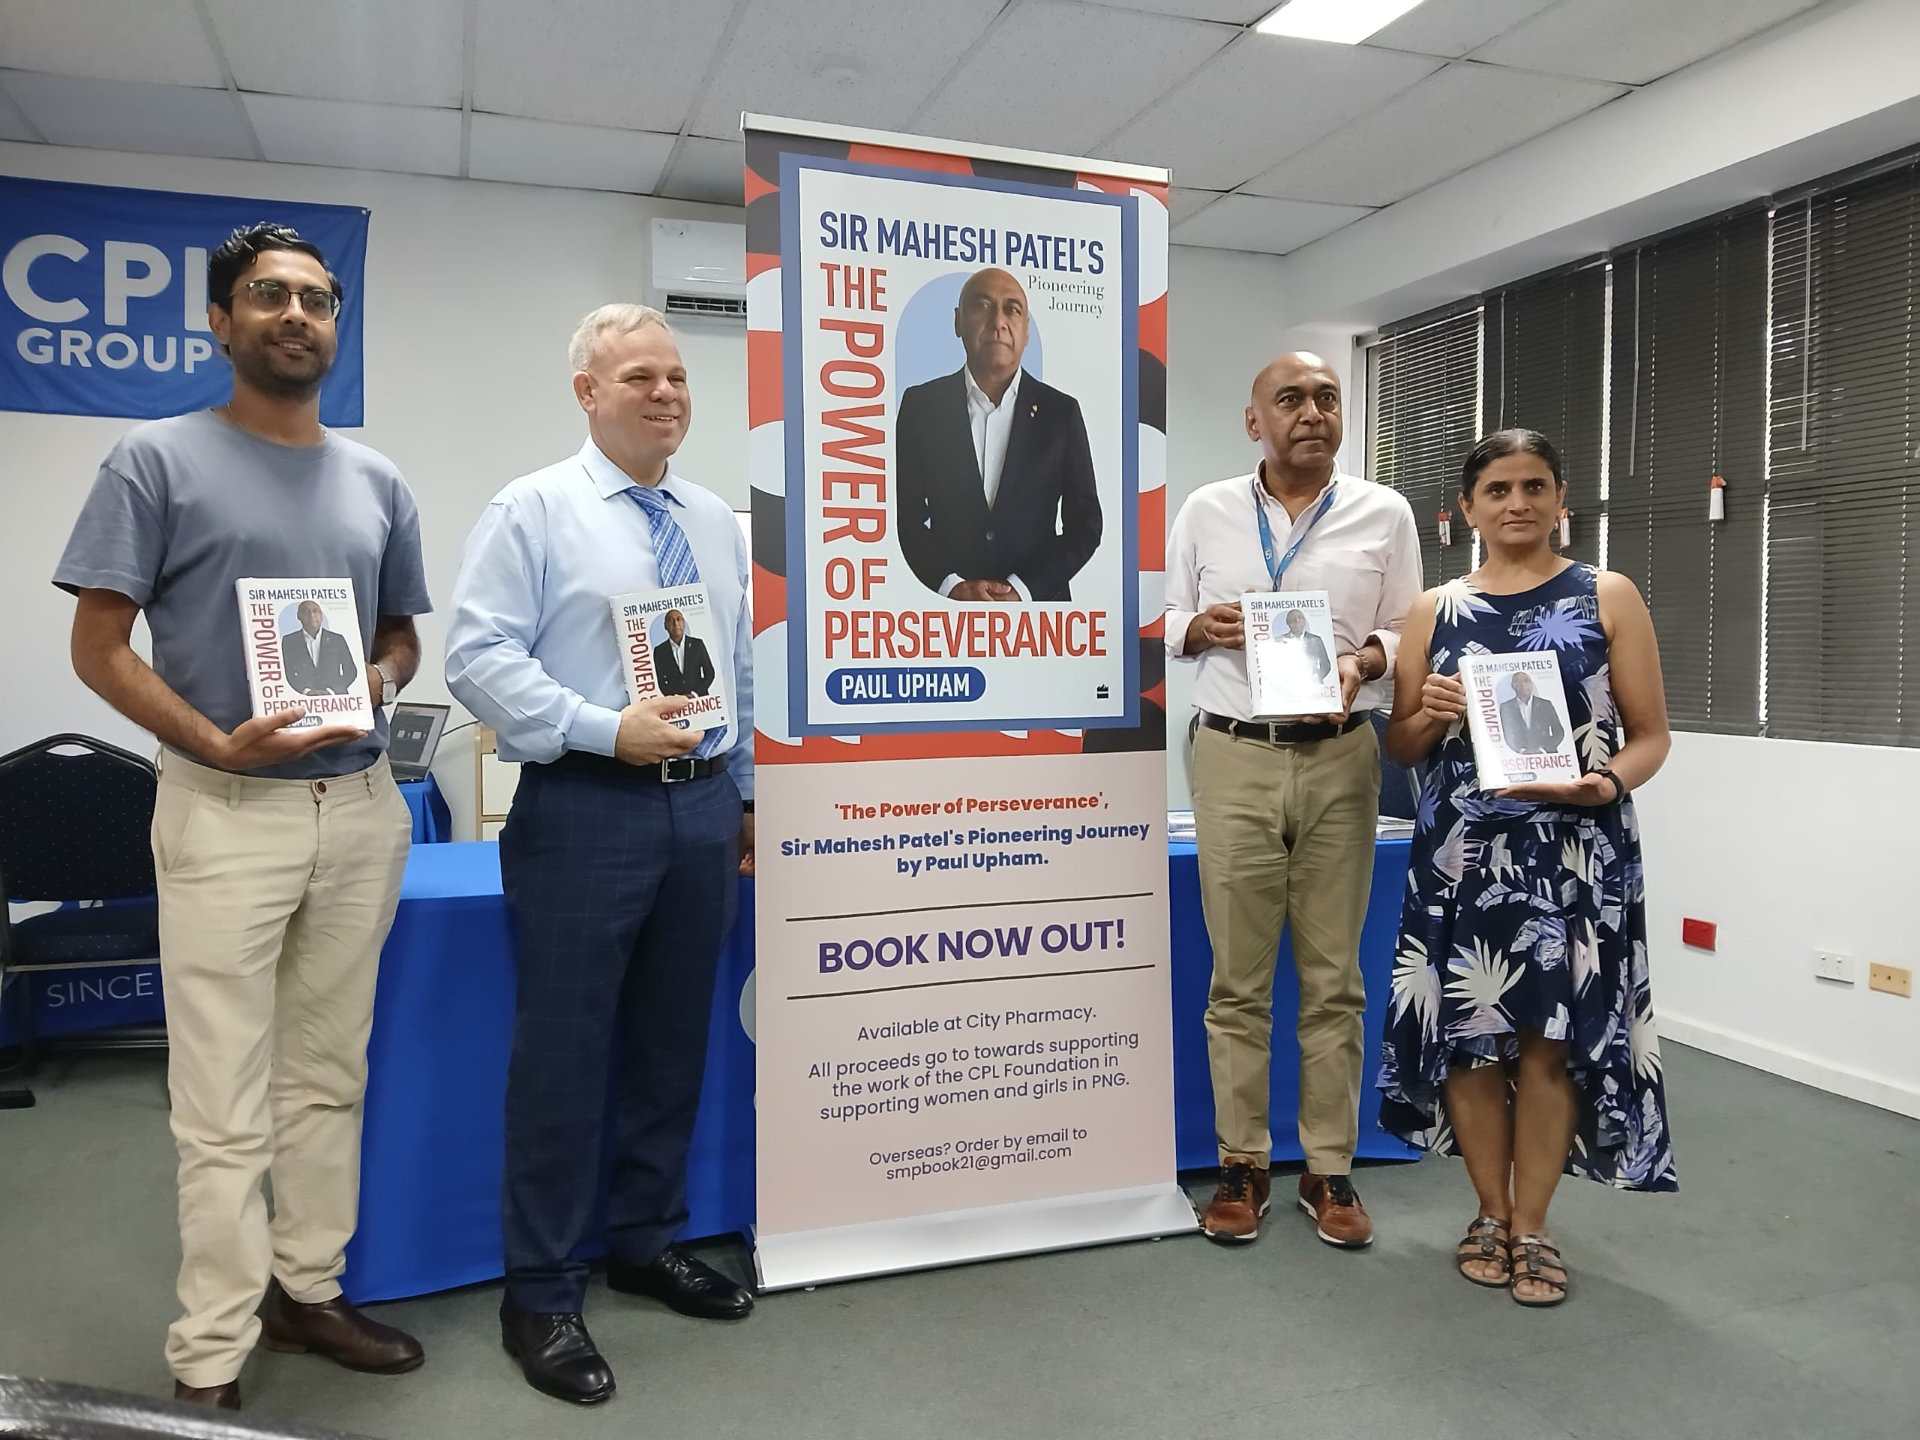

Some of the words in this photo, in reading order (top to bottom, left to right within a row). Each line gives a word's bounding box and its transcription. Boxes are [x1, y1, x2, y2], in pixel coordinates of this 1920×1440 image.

[820, 211, 868, 252] SIR
[878, 218, 997, 264] MAHESH
[1005, 231, 1104, 275] PATEL'S
[820, 262, 887, 312] THE
[1027, 275, 1104, 300] Pioneering
[1049, 298, 1105, 318] Journey
[17, 328, 213, 373] GROUP
[820, 318, 887, 544] POWER
[249, 590, 265, 600] SIR
[268, 589, 309, 599] MAHESH
[311, 589, 346, 599] PATEL'S
[825, 558, 888, 600] OF
[251, 604, 274, 615] THE
[623, 605, 638, 616] SIR
[640, 599, 672, 614] MAHESH
[674, 594, 703, 607] PATEL'S
[1251, 601, 1263, 610] SIR
[1265, 601, 1295, 609] MAHESH
[1297, 600, 1324, 608] PATEL'S
[1252, 612, 1268, 622] THE
[626, 618, 646, 631] THE
[825, 611, 1107, 659] PERSEVERANCE
[252, 619, 282, 682] POWER
[628, 633, 655, 694] POWER
[1471, 664, 1484, 674] SIR
[1486, 662, 1520, 672] MAHESH
[1522, 660, 1552, 670] PATEL'S
[262, 685, 284, 698] OF
[841, 674, 892, 699] PAUL
[898, 673, 970, 697] UPHAM
[1474, 676, 1492, 687] THE
[1502, 755, 1572, 771] RSEVERANCE
[835, 804, 876, 820] 'The
[880, 802, 941, 819] Power
[944, 798, 964, 814] of
[967, 792, 1108, 813] Perseverance',
[781, 839, 810, 855] Sir
[814, 834, 895, 854] Mahesh
[900, 829, 964, 849] Patel's
[969, 825, 1072, 847] Pioneering
[1076, 822, 1150, 840] Journey
[897, 858, 921, 877] by
[926, 853, 969, 871] Paul
[973, 852, 1049, 872] Upham.
[819, 934, 929, 974] BOOK
[938, 926, 1033, 961] NOW
[1041, 919, 1125, 953] OUT!
[48, 973, 154, 1007] SINCE
[857, 1018, 939, 1041] Available
[944, 1015, 961, 1030] at
[966, 1013, 1000, 1030] City
[1005, 1006, 1096, 1025] Pharmacy.
[809, 1062, 831, 1078] All
[836, 1053, 920, 1080] proceeds
[925, 1053, 948, 1066] go
[952, 1047, 969, 1062] to
[974, 1040, 1044, 1060] towards
[1049, 1032, 1139, 1054] supporting
[832, 1082, 862, 1097] the
[867, 1076, 909, 1094] work
[914, 1070, 931, 1088] of
[936, 1068, 963, 1083] the
[968, 1066, 1000, 1081] CPL
[1004, 1057, 1100, 1077] Foundation
[1104, 1053, 1118, 1067] in
[820, 1097, 919, 1122] supporting
[924, 1088, 989, 1106] women
[994, 1083, 1028, 1099] and
[1033, 1077, 1068, 1099] girls
[1072, 1075, 1087, 1089] in
[1092, 1073, 1130, 1088] PNG.
[869, 1142, 951, 1166] Overseas?
[955, 1139, 999, 1154] Order
[1003, 1134, 1022, 1150] by
[1026, 1129, 1068, 1146] email
[1072, 1128, 1087, 1140] to
[886, 1145, 1072, 1180] smpbook21@gmail.com
